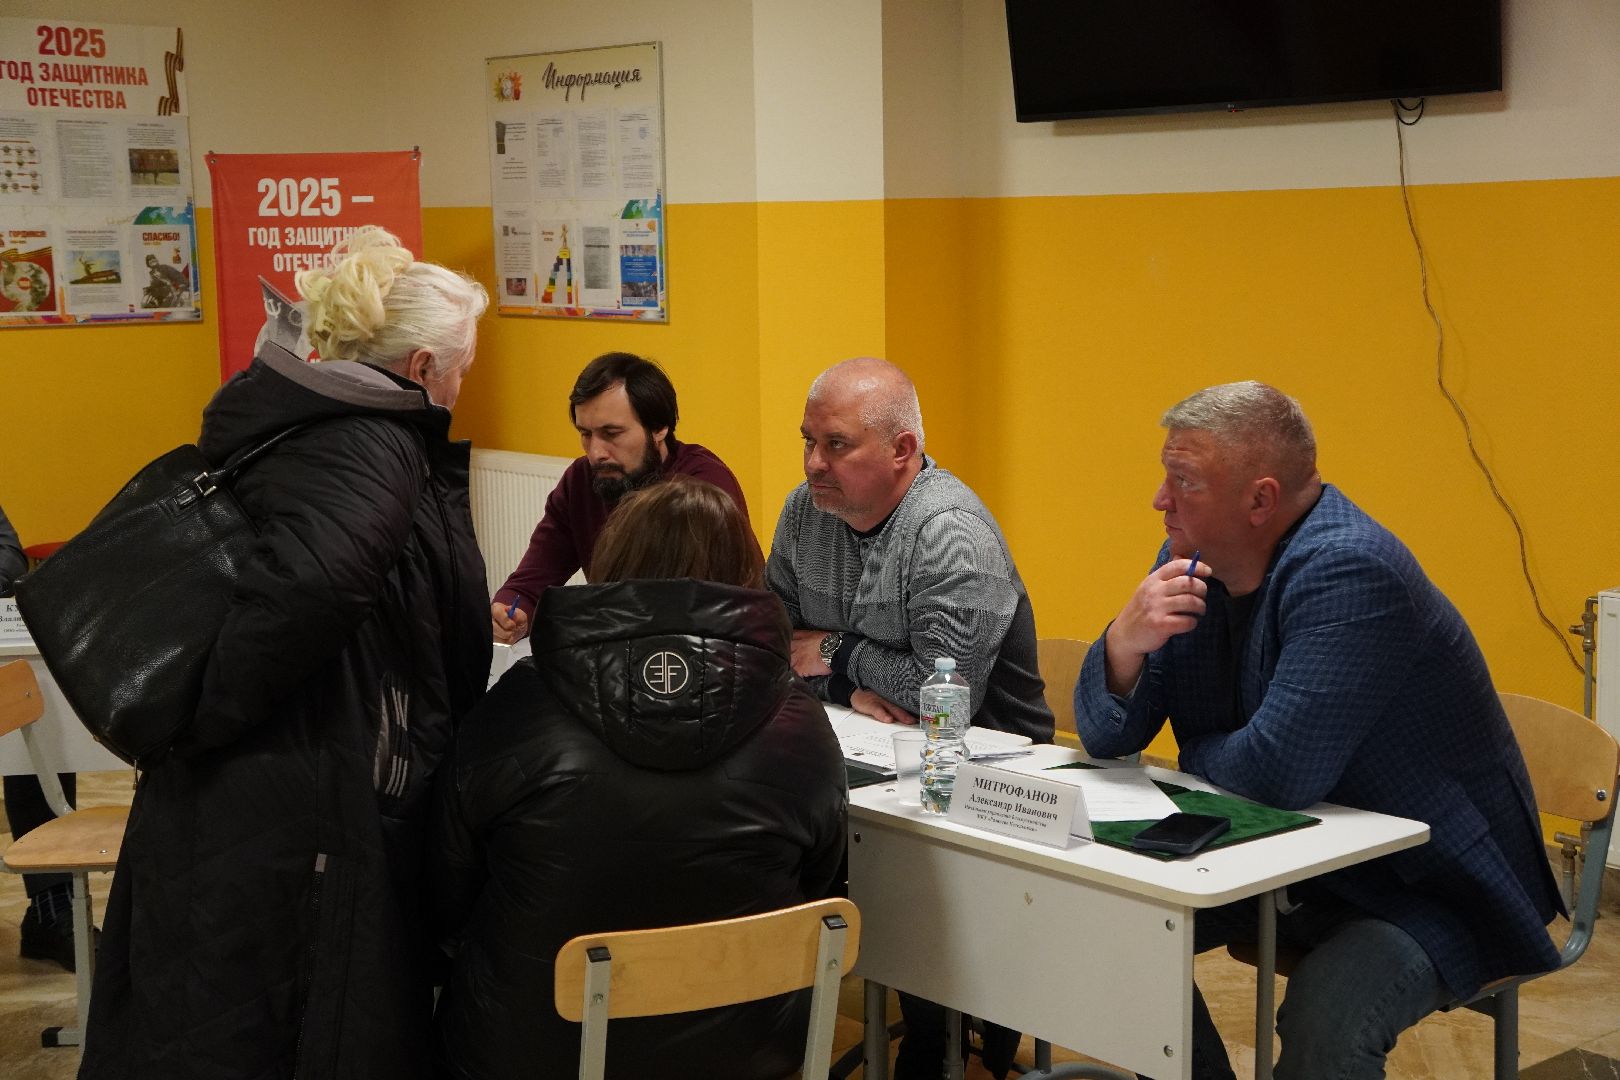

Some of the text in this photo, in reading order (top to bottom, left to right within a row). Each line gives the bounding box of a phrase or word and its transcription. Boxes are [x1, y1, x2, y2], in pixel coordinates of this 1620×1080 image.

[37, 25, 106, 58] 2025
[0, 60, 148, 86] ГОД ЗАЩИТНИКА
[542, 62, 641, 102] Информация
[27, 87, 127, 110] ОТЕЧЕСТВА
[257, 177, 341, 217] 2025
[248, 227, 280, 249] ГОД
[972, 777, 1058, 805] МИТРОФАНОВ
[968, 793, 1013, 813] Александр
[1014, 802, 1058, 821] Иванович
